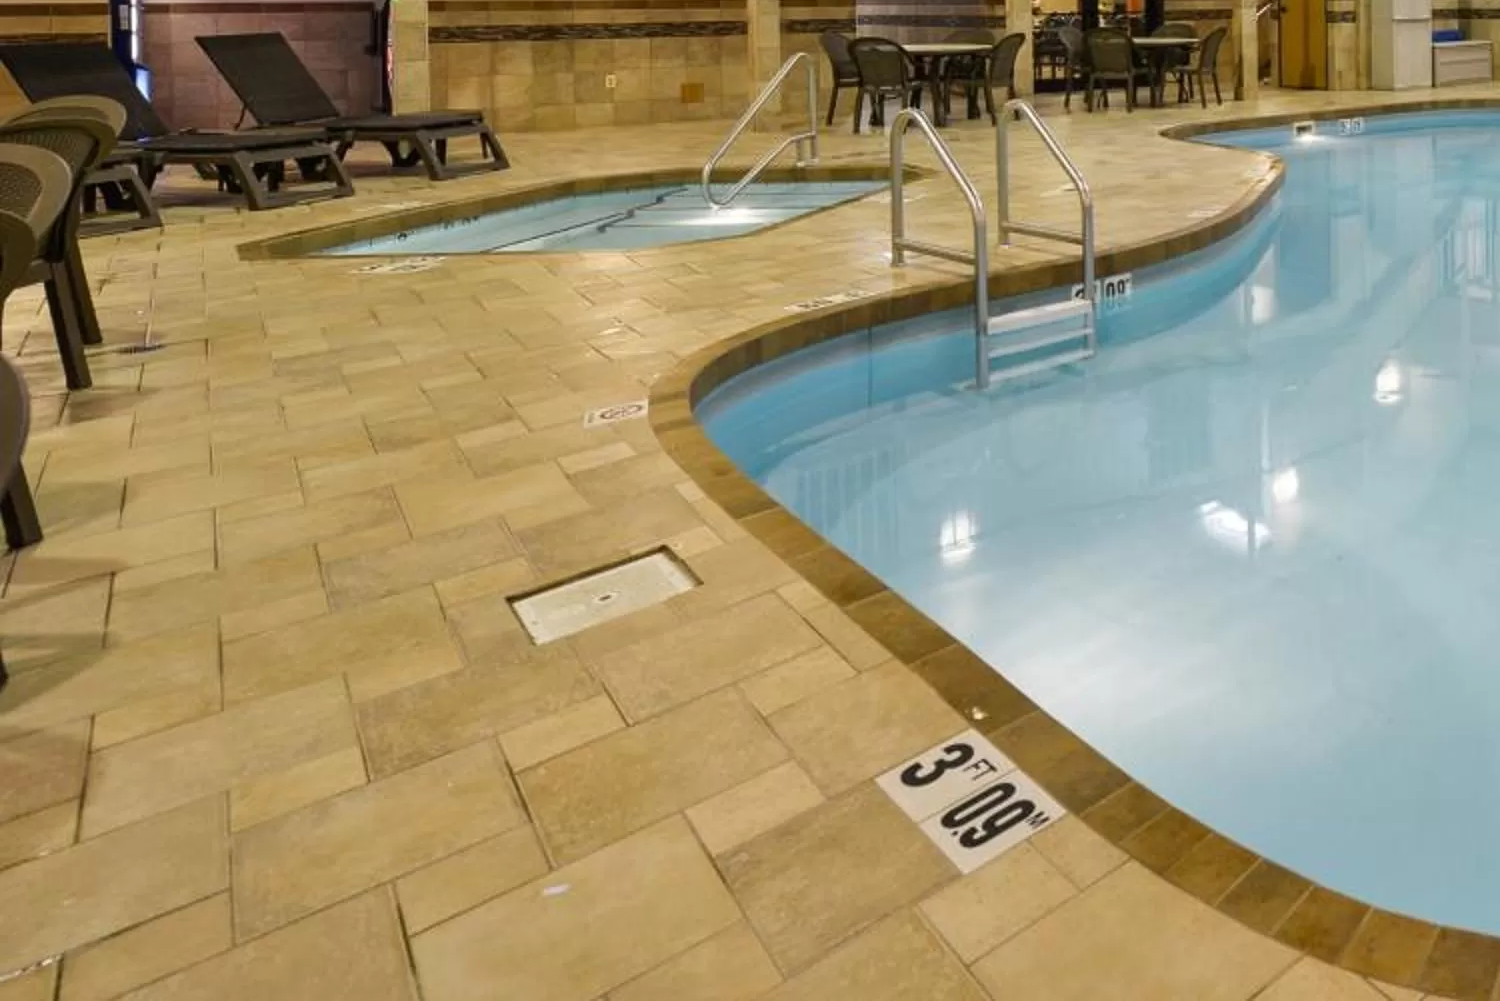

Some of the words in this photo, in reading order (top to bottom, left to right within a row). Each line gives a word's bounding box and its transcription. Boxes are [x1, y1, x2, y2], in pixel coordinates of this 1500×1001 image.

[900, 742, 975, 788] 3
[963, 758, 998, 781] FT
[1025, 811, 1050, 828] M
